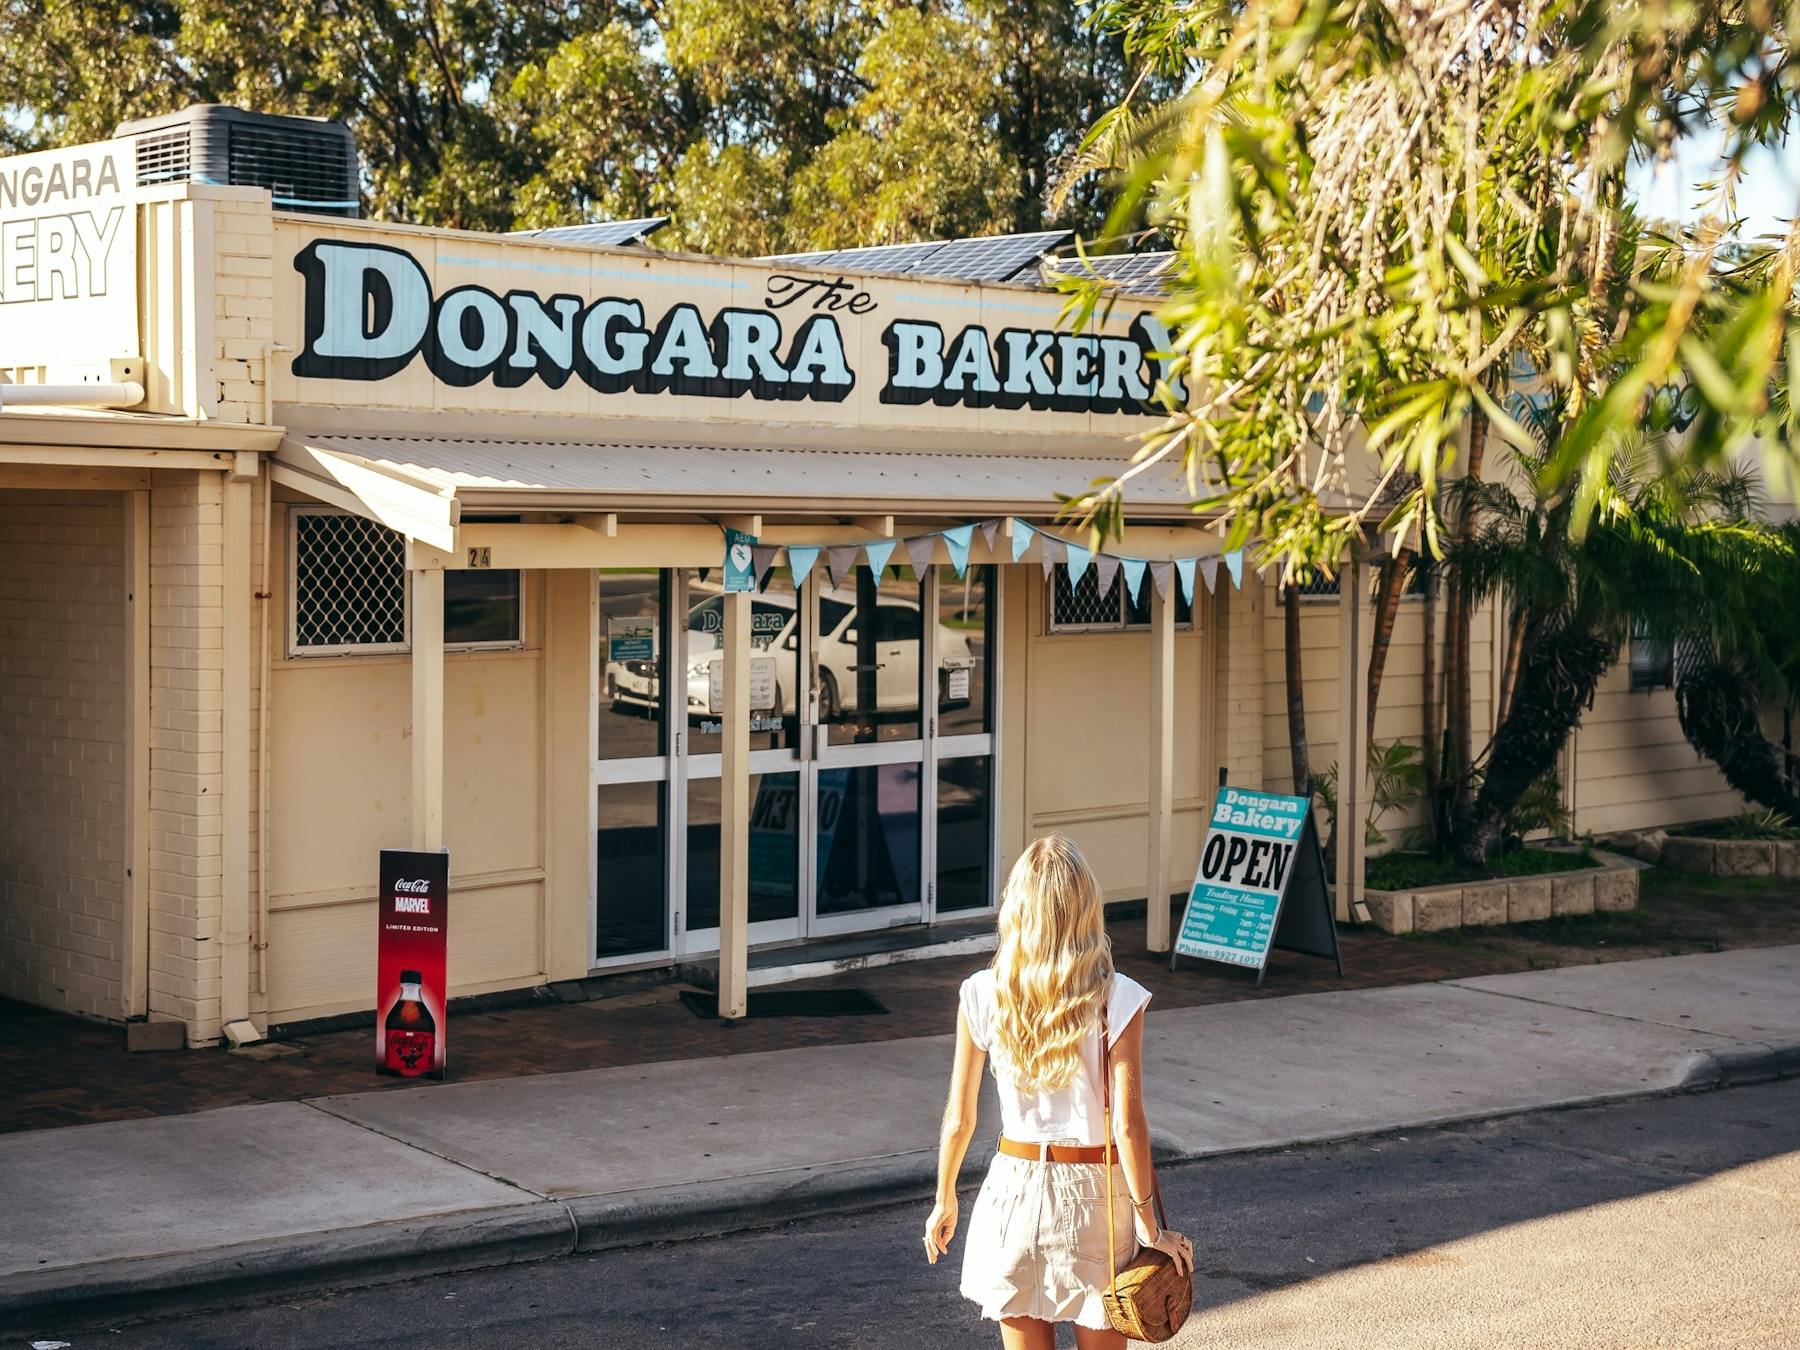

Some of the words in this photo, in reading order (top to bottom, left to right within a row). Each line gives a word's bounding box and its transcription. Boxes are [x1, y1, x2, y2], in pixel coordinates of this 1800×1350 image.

[0, 205, 126, 305] ERY
[765, 275, 878, 315] The
[292, 239, 856, 403] DONGARA
[470, 549, 489, 567] 24
[703, 609, 784, 632] Dara
[1225, 790, 1297, 811] Dongara
[1213, 804, 1302, 836] Bakery
[1202, 833, 1292, 890] OPEN
[395, 896, 430, 914] MARVEL
[1207, 888, 1238, 904] Trading
[1179, 943, 1213, 955] Phone:
